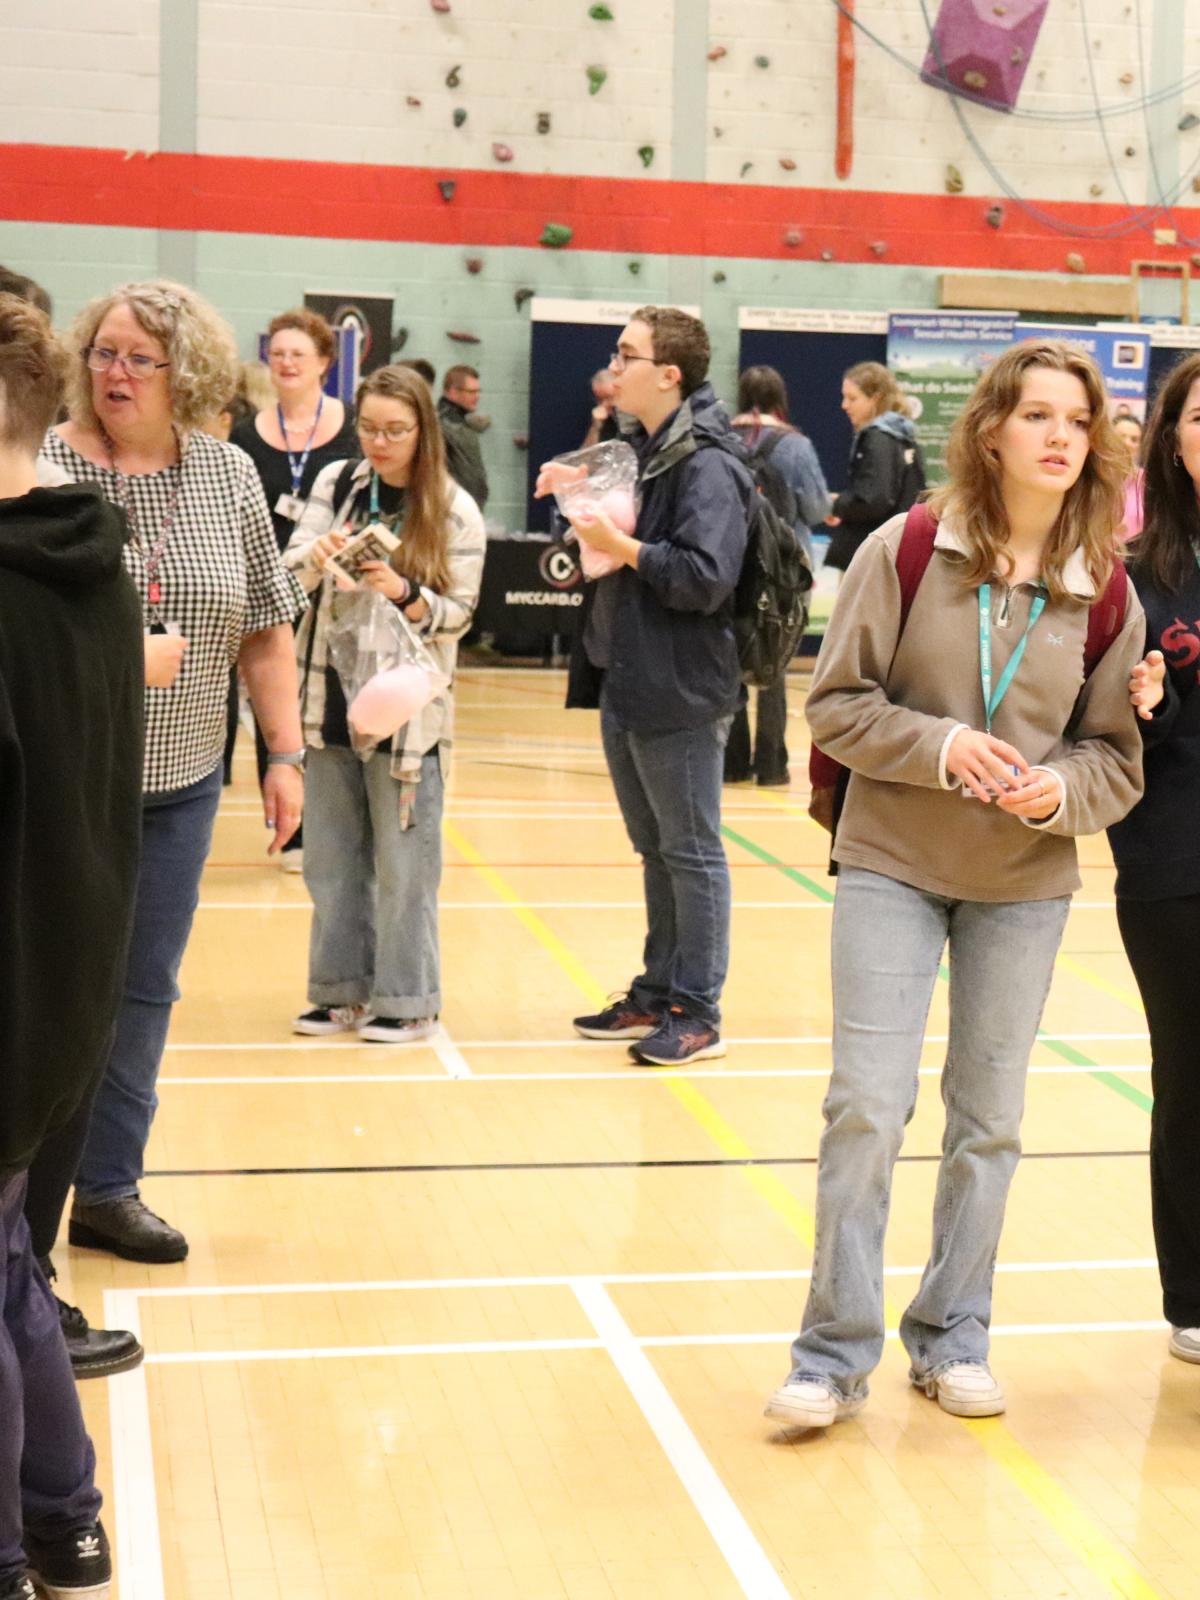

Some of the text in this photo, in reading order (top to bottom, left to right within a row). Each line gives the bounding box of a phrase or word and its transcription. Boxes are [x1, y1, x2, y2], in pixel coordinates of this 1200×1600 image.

[891, 316, 1015, 332] Somerset Wide Integrated
[913, 328, 945, 338] Sexual
[945, 329, 979, 340] Health
